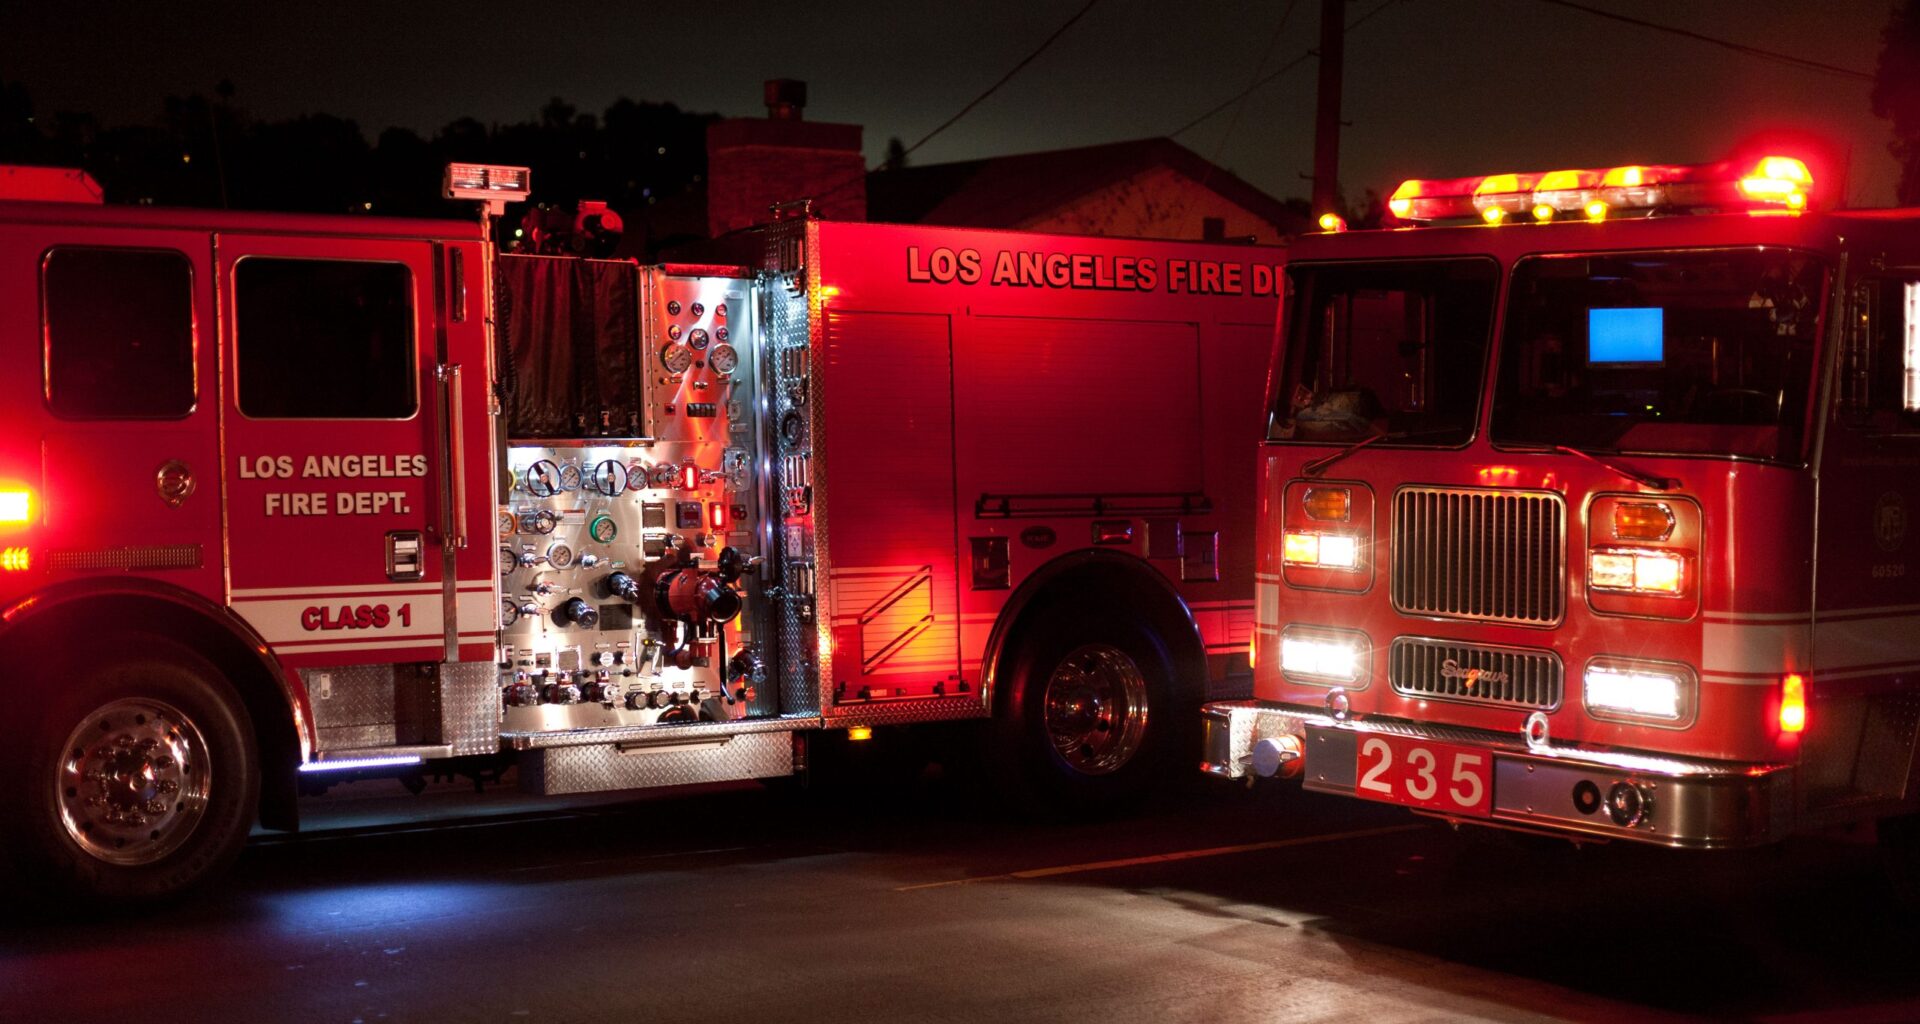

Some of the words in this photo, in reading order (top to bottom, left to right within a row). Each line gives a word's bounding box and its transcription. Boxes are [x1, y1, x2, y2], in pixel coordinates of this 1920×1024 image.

[907, 247, 982, 283] LOS
[991, 251, 1158, 292] ANGELES
[1167, 260, 1243, 294] FIRE
[239, 455, 293, 479] LOS
[302, 455, 429, 478] ANGELES
[265, 493, 328, 516] FIRE
[337, 492, 410, 514] DEPT.
[302, 605, 390, 631] CLASS
[398, 603, 411, 627] 1
[1359, 738, 1483, 807] 235
